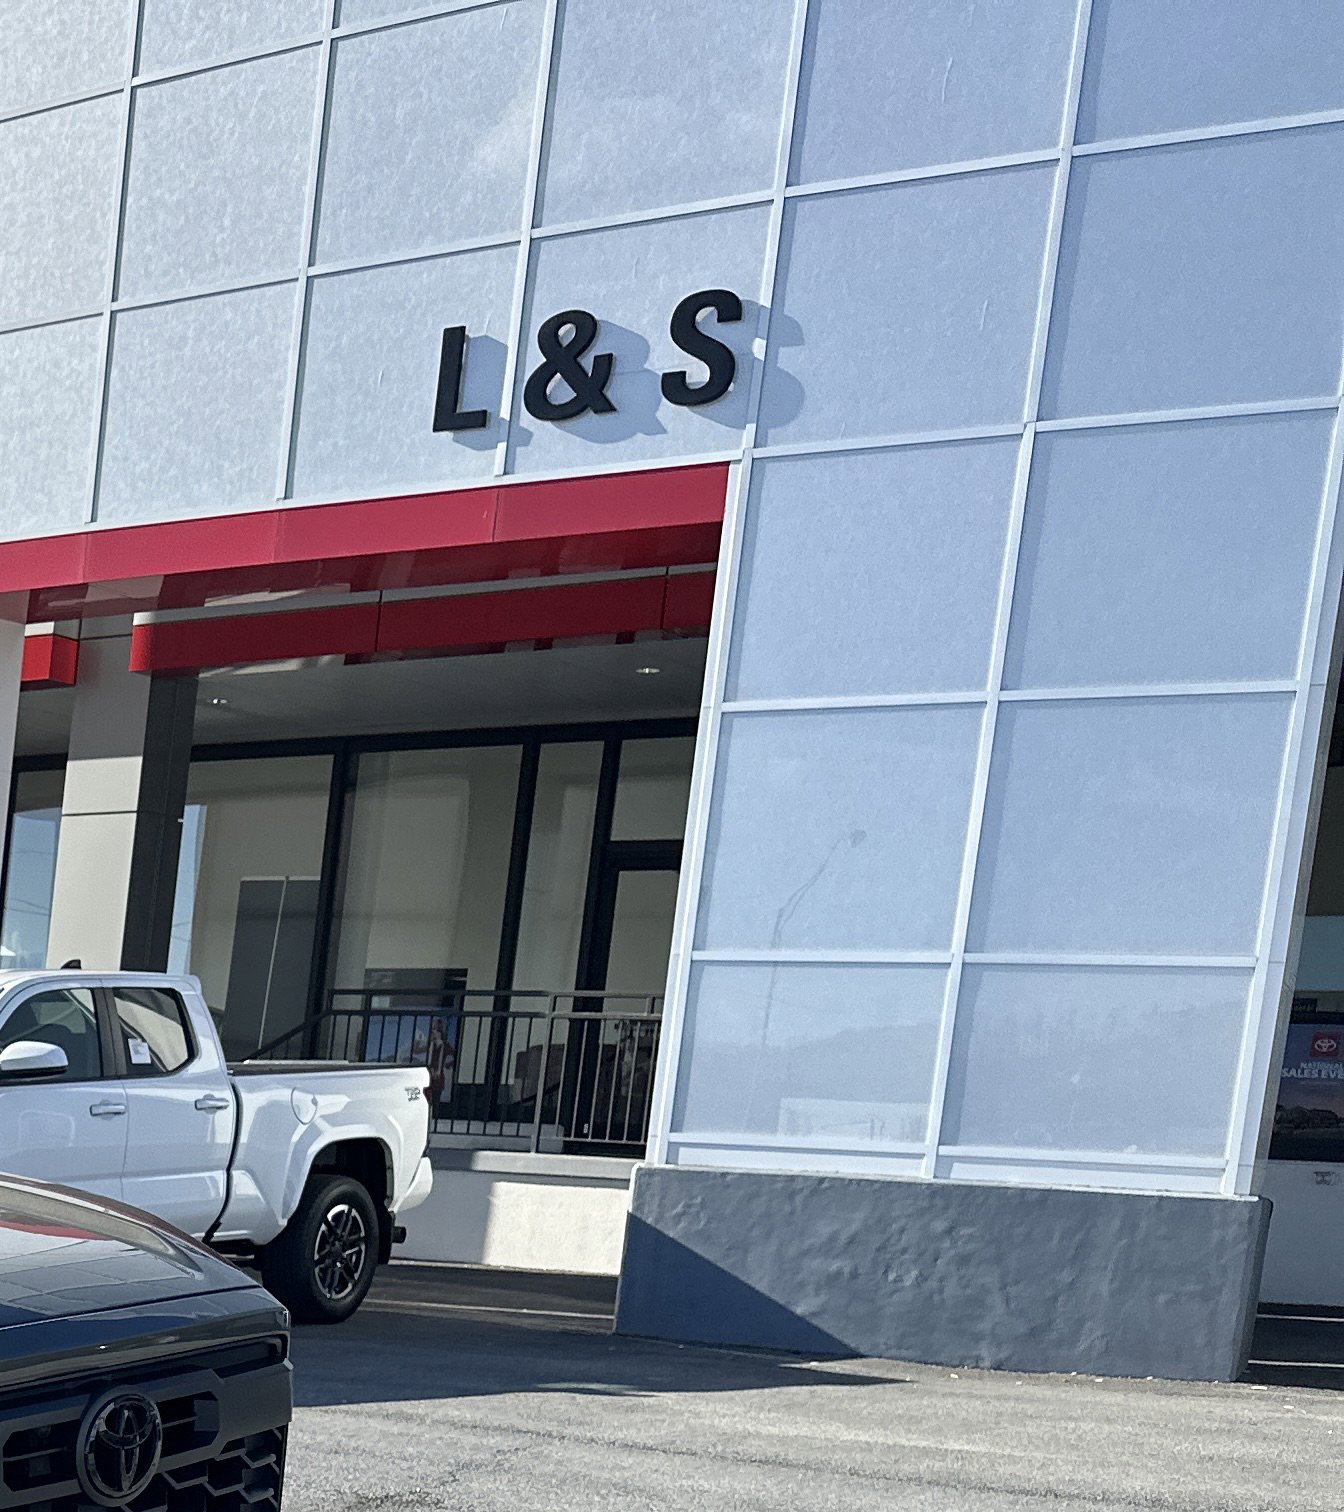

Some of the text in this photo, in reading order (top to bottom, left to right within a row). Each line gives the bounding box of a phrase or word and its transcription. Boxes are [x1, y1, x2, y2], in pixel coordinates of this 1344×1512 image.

[433, 288, 743, 433] L & S
